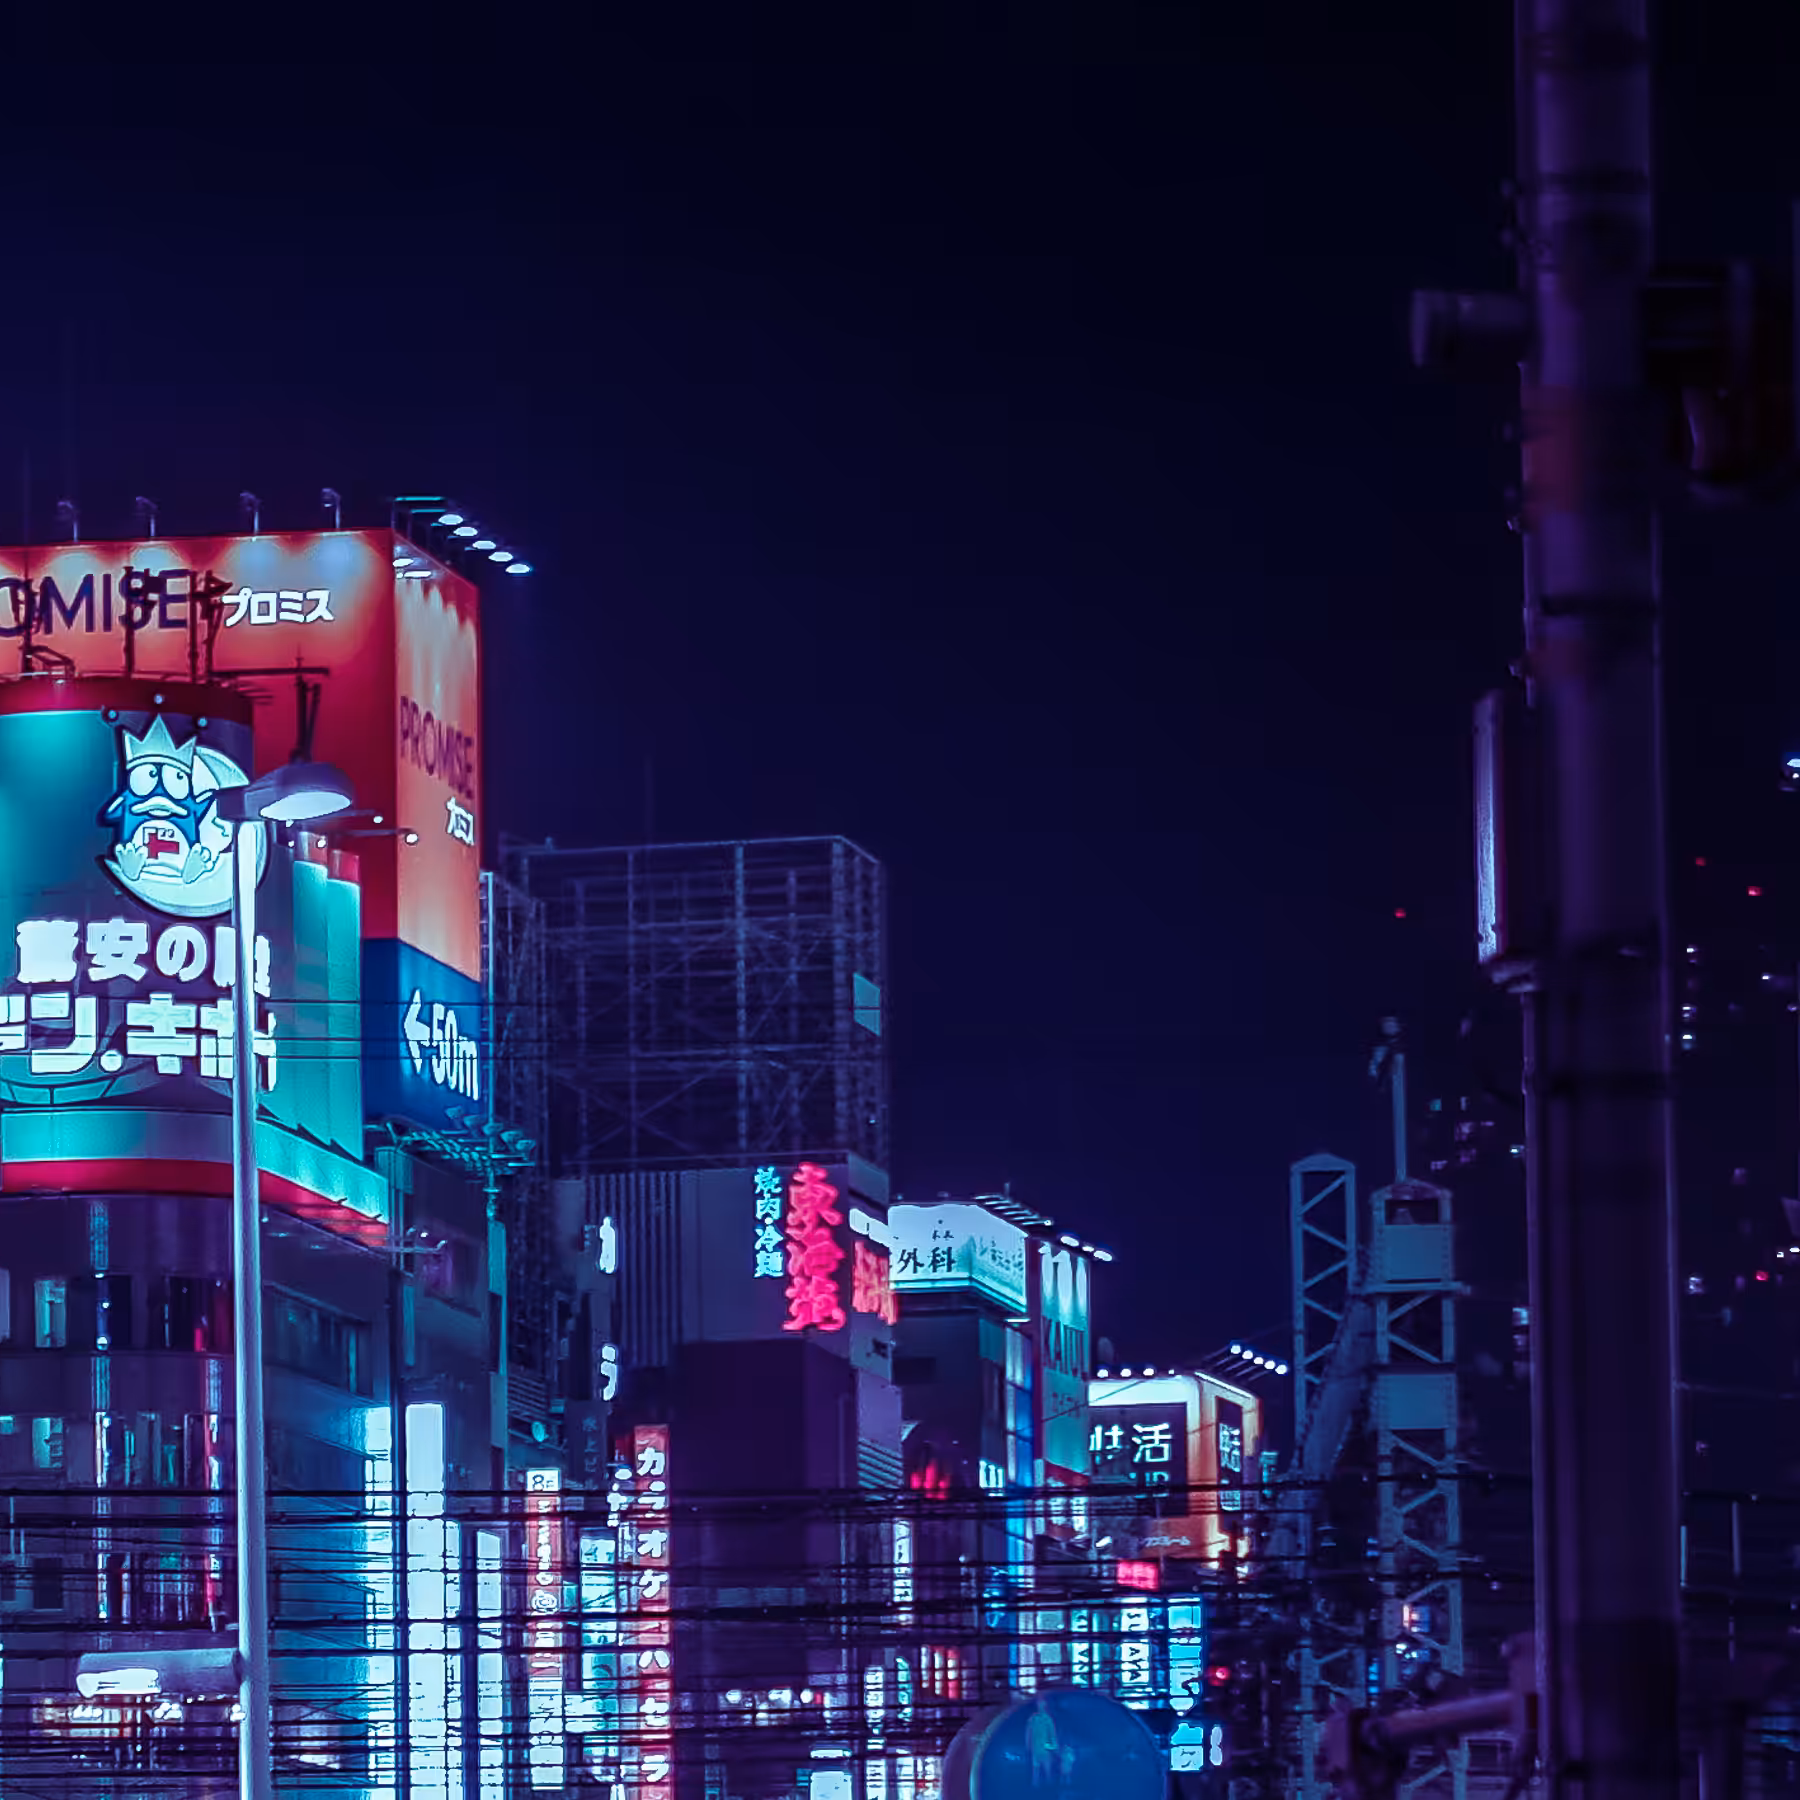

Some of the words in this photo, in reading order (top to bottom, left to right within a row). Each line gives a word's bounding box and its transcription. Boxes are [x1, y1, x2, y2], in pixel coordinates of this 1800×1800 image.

[222, 586, 335, 628] プロミス
[431, 996, 480, 1101] 50m
